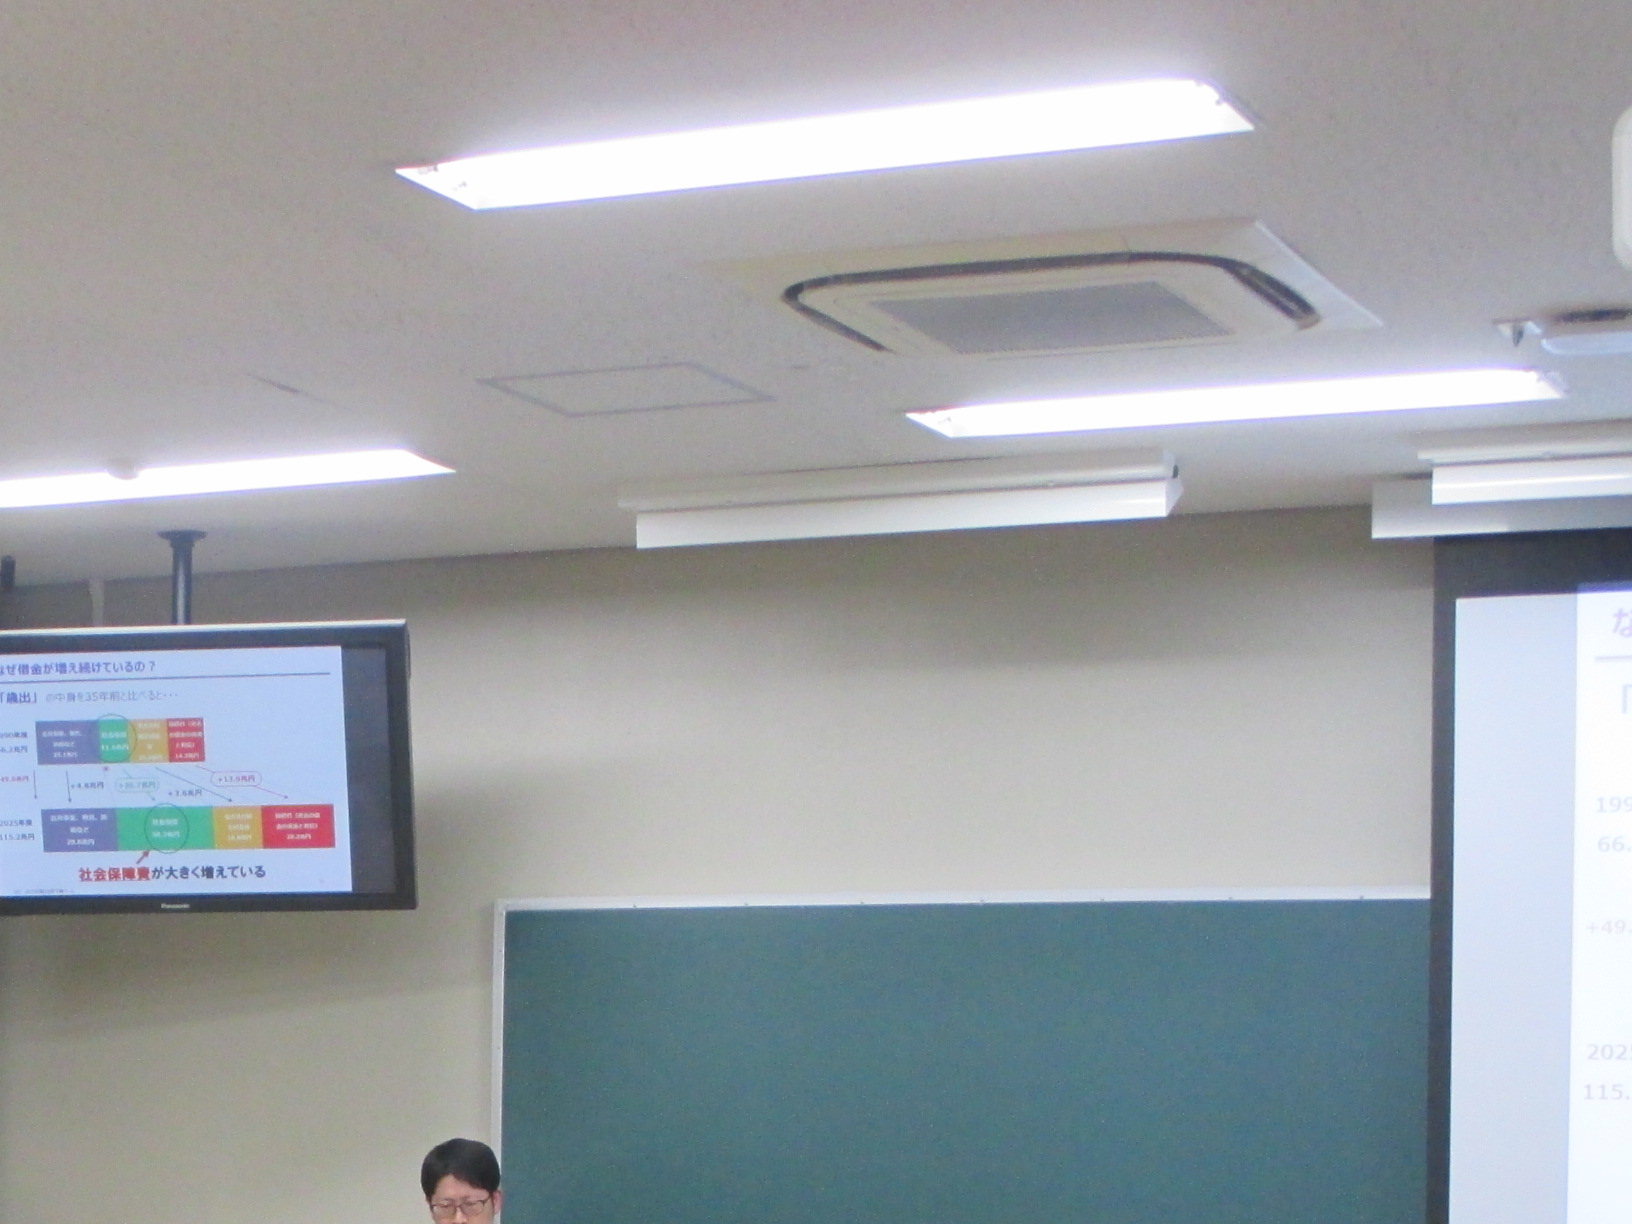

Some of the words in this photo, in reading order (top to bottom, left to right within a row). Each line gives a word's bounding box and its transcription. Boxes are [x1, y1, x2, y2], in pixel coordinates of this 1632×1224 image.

[79, 865, 266, 882] 社会保障費が大きく増えている
[1586, 1043, 1632, 1061] 202
[1583, 1083, 1631, 1101] 115.
